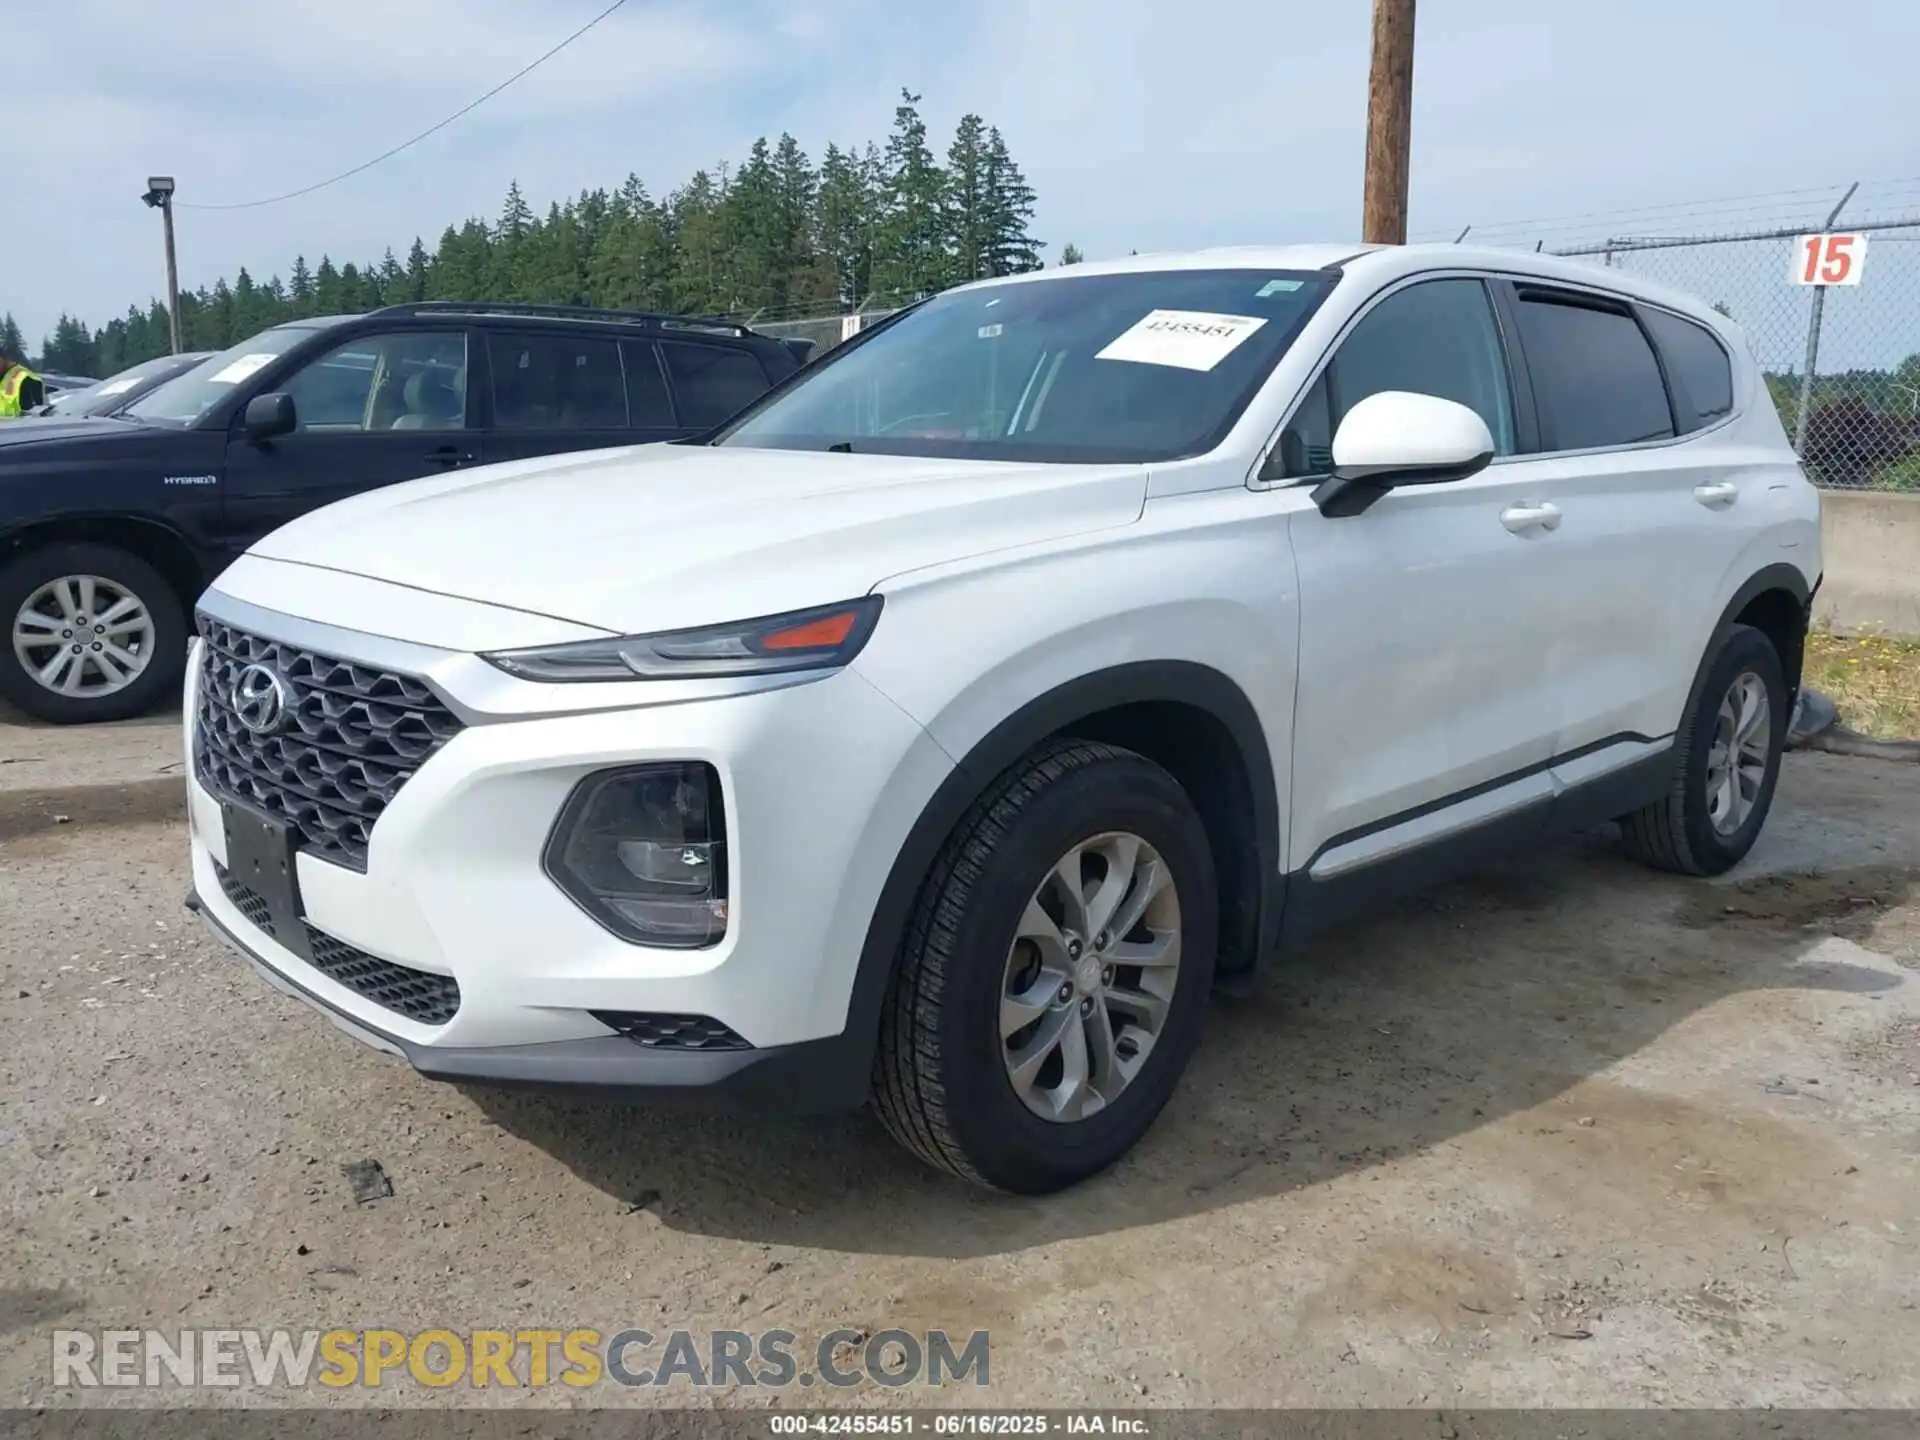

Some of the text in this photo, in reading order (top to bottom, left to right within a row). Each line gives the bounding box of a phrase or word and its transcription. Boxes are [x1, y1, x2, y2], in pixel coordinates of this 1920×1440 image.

[1804, 236, 1854, 283] 15
[1146, 321, 1236, 338] 42455451
[164, 475, 217, 485] HYBRID
